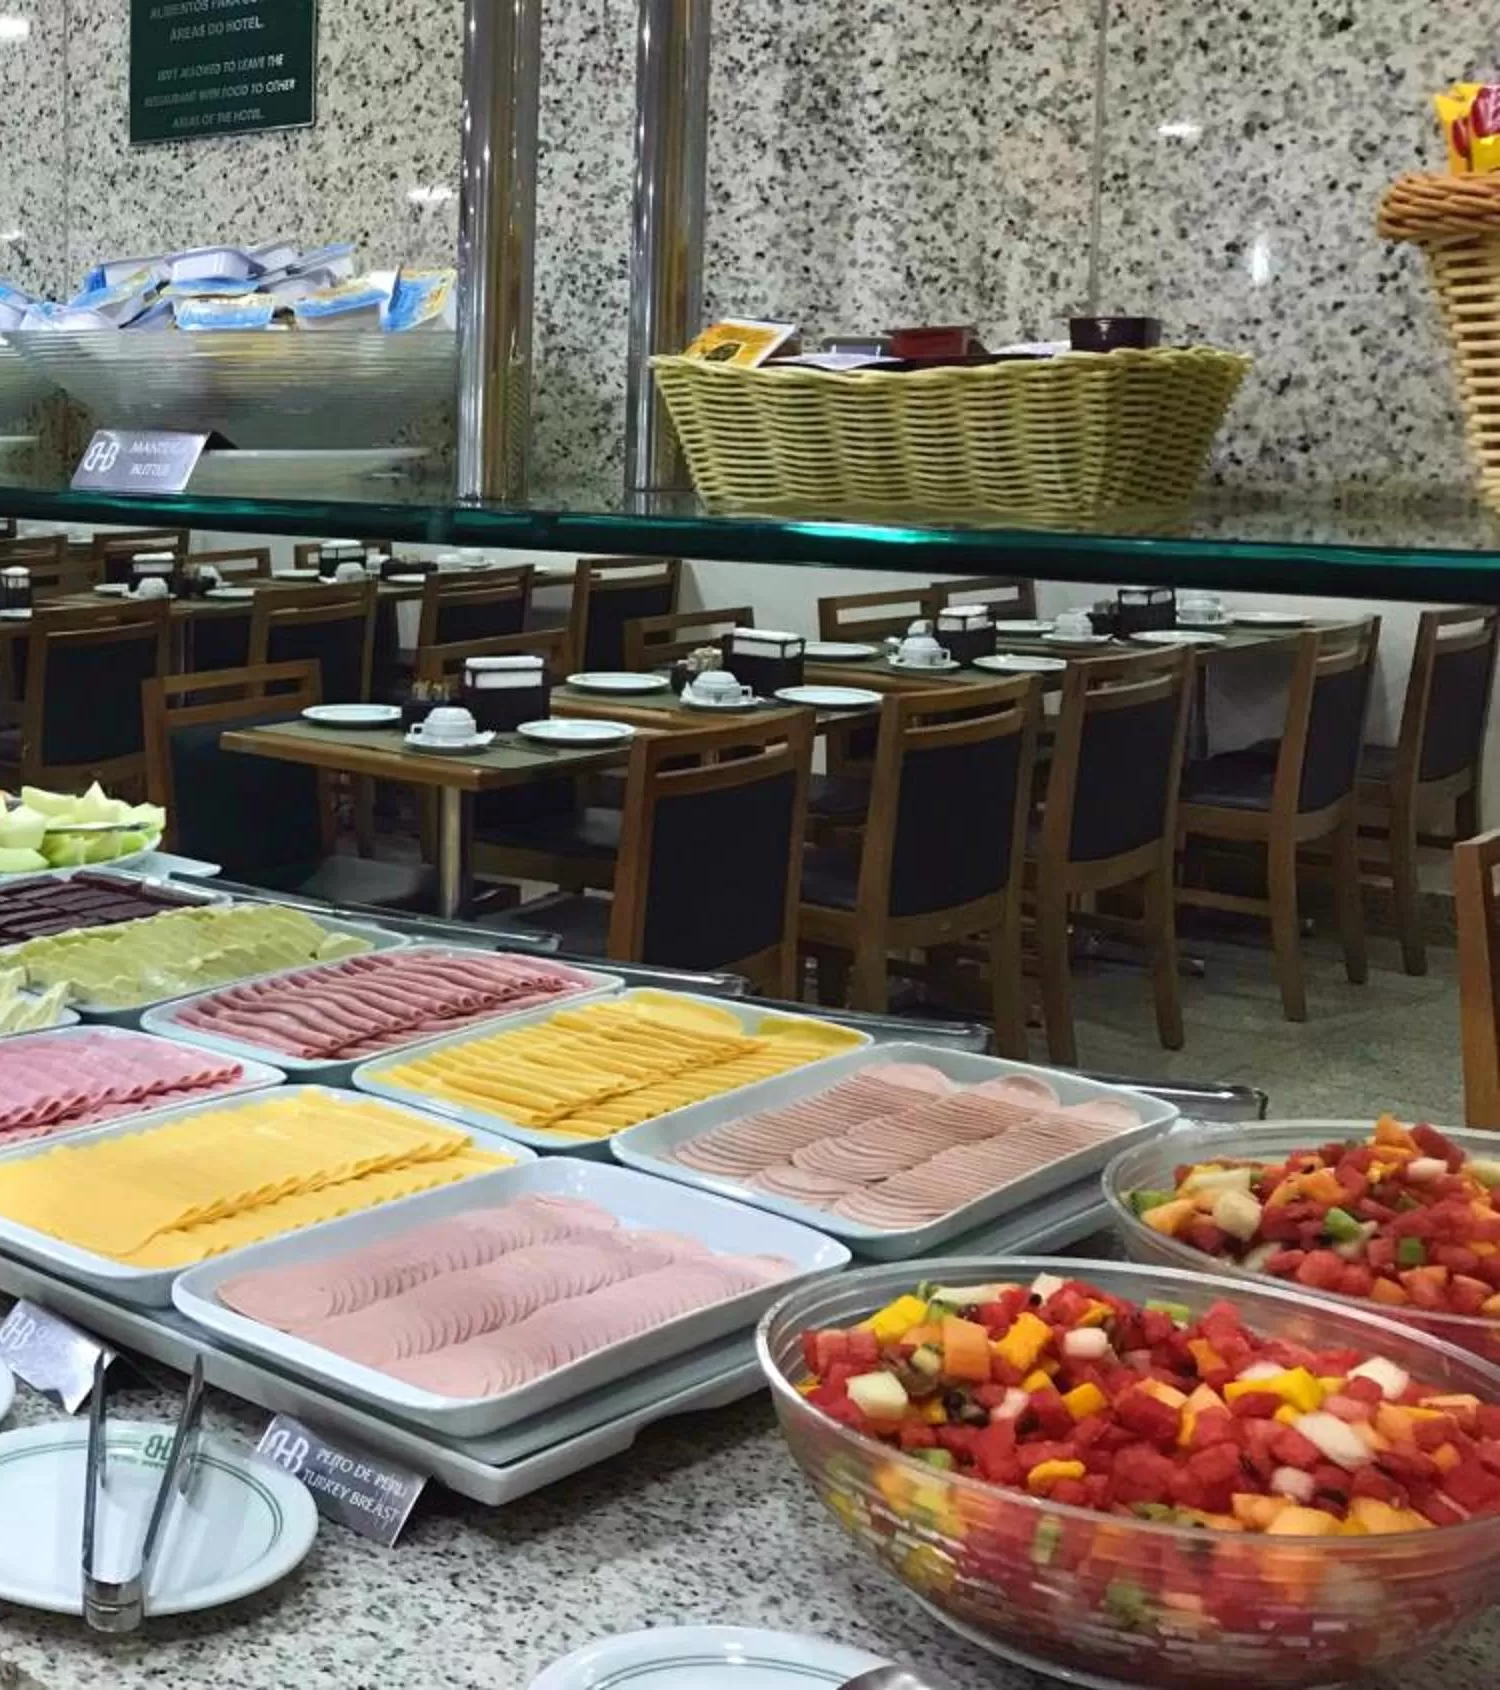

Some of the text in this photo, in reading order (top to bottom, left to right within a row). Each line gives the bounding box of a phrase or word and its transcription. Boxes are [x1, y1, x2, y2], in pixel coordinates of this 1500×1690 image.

[224, 60, 236, 74] TO
[238, 56, 266, 71] LEAVE
[268, 53, 285, 68] THE
[222, 84, 249, 98] FOOD
[251, 82, 263, 95] TO
[265, 77, 297, 93] OTHER
[314, 1447, 351, 1474] PEITO
[354, 1465, 372, 1482] DE
[301, 1467, 401, 1524] TURKEY BREAST
